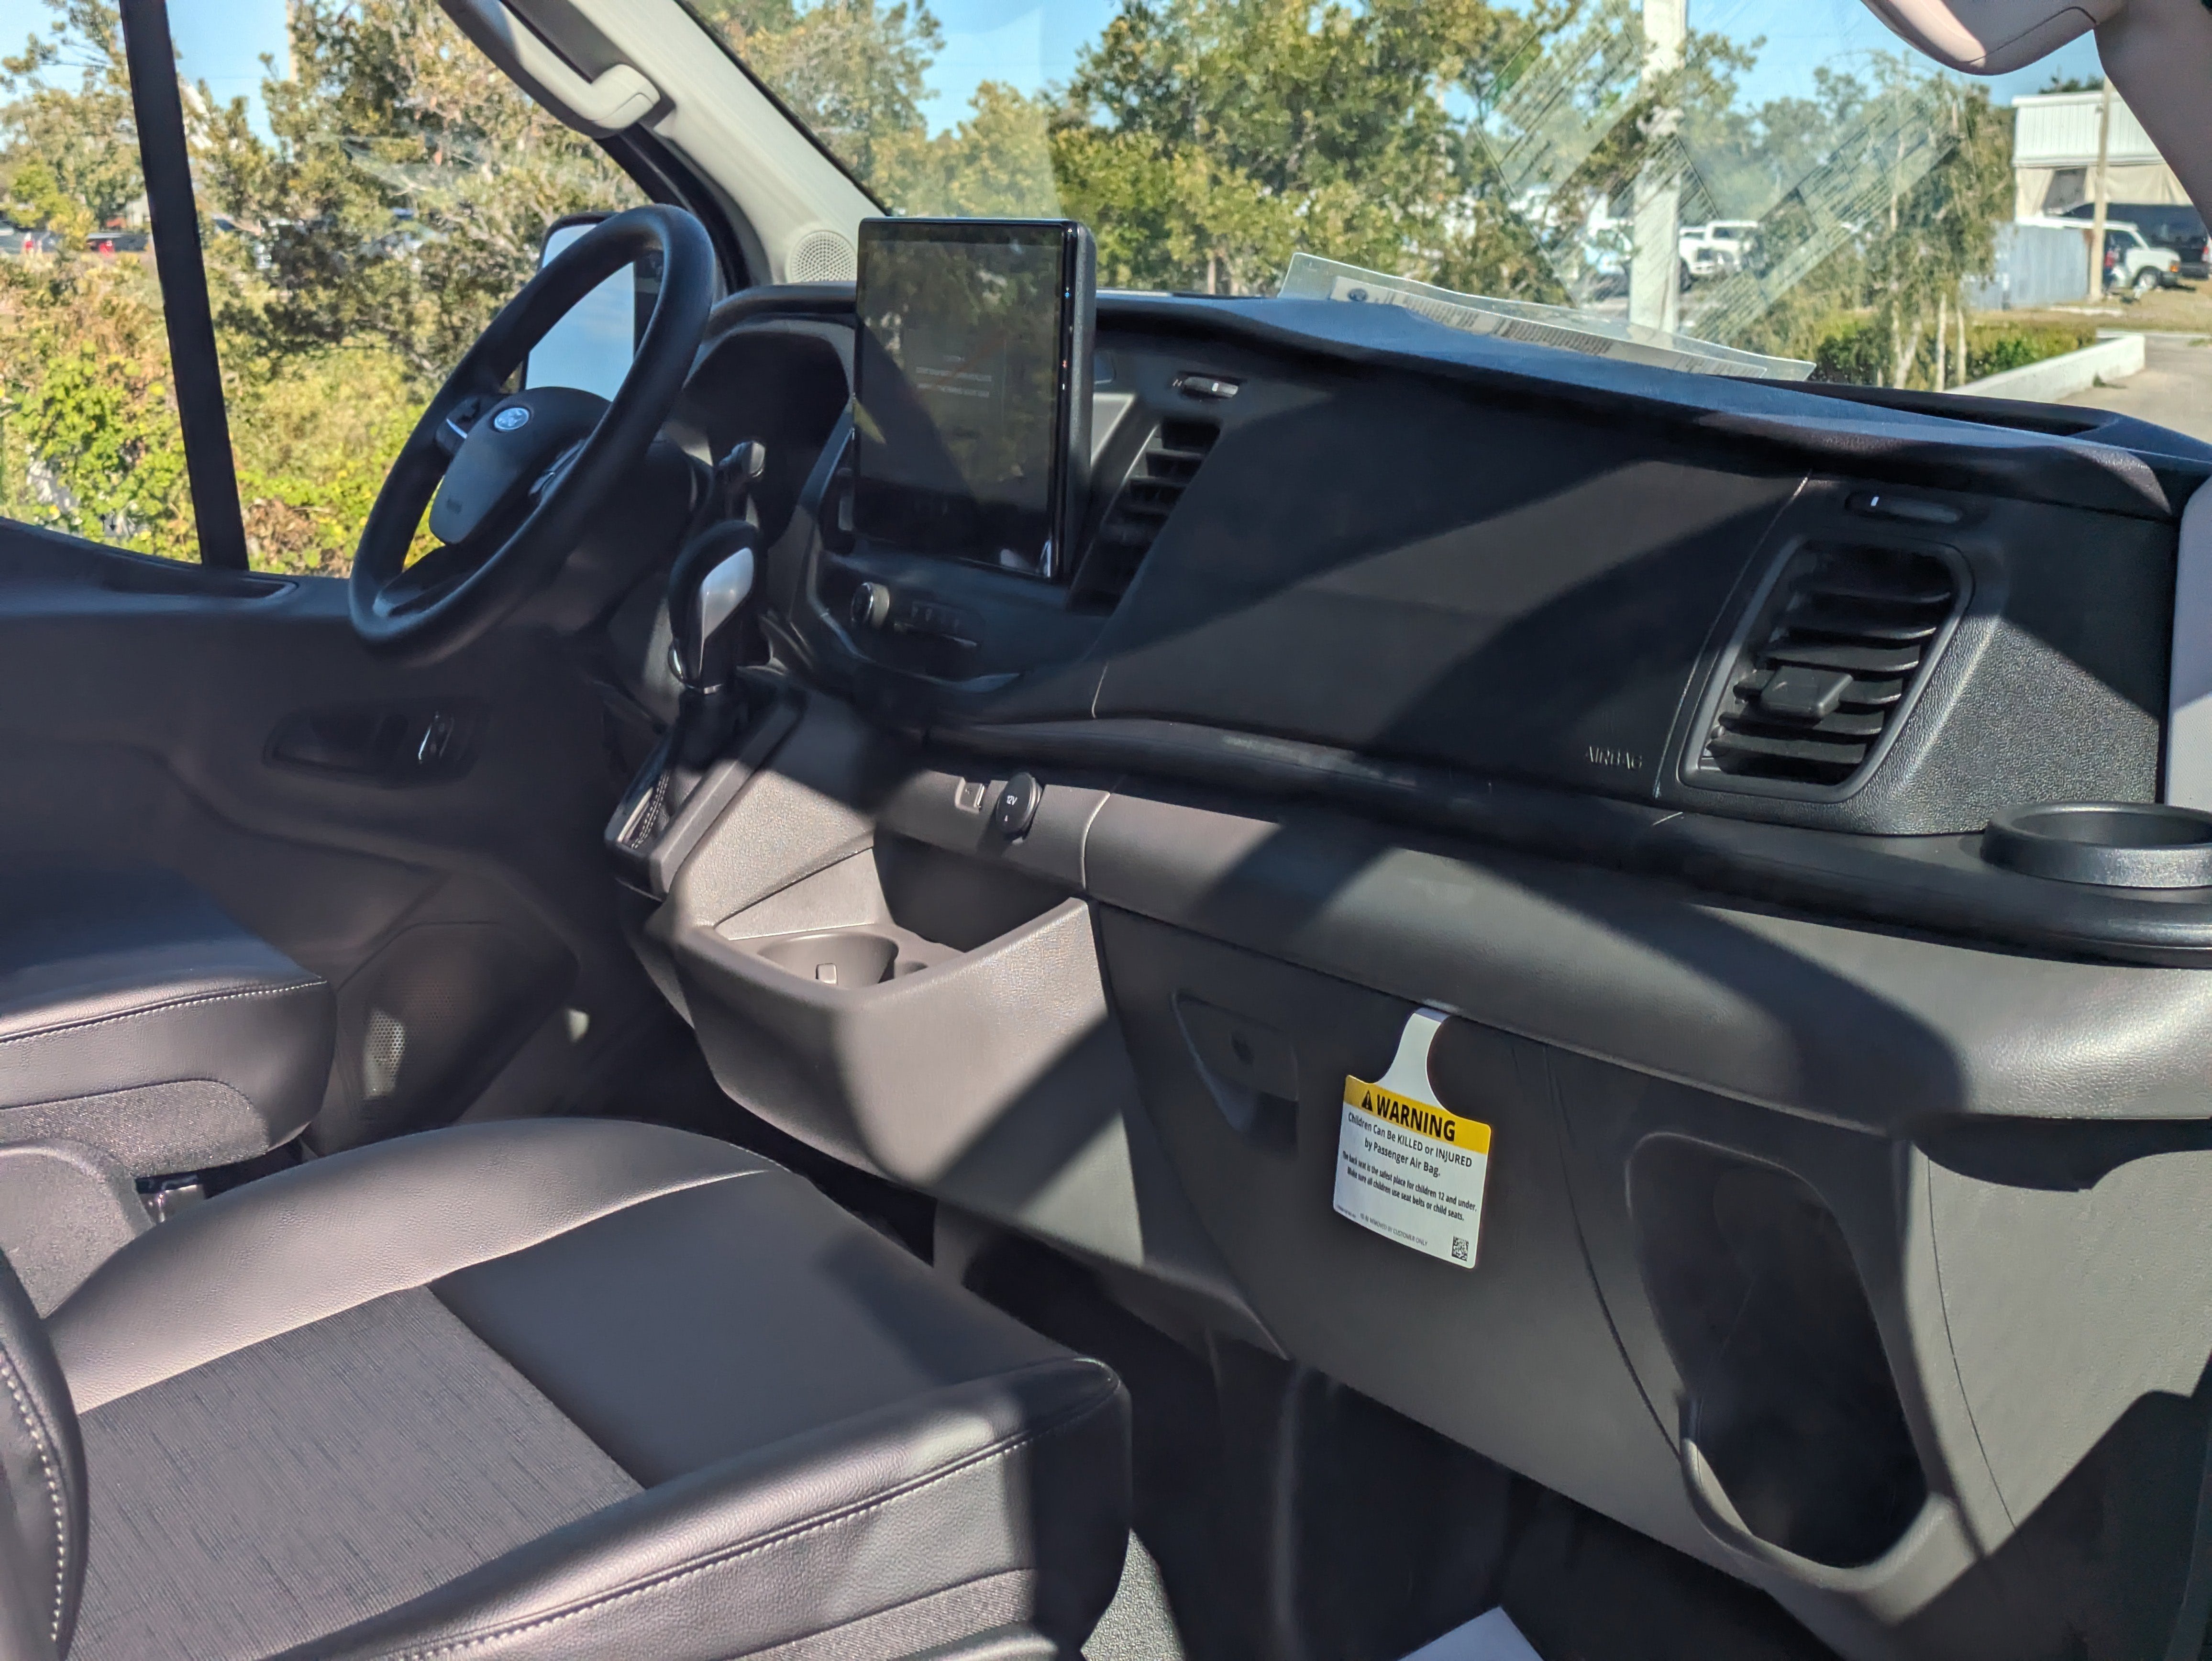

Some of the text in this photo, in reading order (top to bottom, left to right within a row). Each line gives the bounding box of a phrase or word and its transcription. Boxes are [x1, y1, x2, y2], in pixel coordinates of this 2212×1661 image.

[1006, 795, 1018, 806] 12V
[1348, 1112, 1472, 1167] Children Can Be KILLED or INJURED
[1377, 1094, 1456, 1142] WARNING
[1365, 1138, 1441, 1178] by Passenger Air Bag.
[1367, 1163, 1371, 1172] is
[1379, 1168, 1393, 1182] safest
[1393, 1174, 1406, 1186] place
[1415, 1184, 1437, 1199] children
[1438, 1191, 1445, 1201] 12
[1446, 1194, 1457, 1205] and
[1458, 1198, 1477, 1213] under.
[1373, 1178, 1391, 1195] children
[1392, 1188, 1400, 1198] use
[1401, 1192, 1411, 1203] seat
[1412, 1195, 1425, 1208] belts
[1426, 1201, 1433, 1210] or
[1433, 1202, 1447, 1216] child
[1448, 1208, 1464, 1221] seats.
